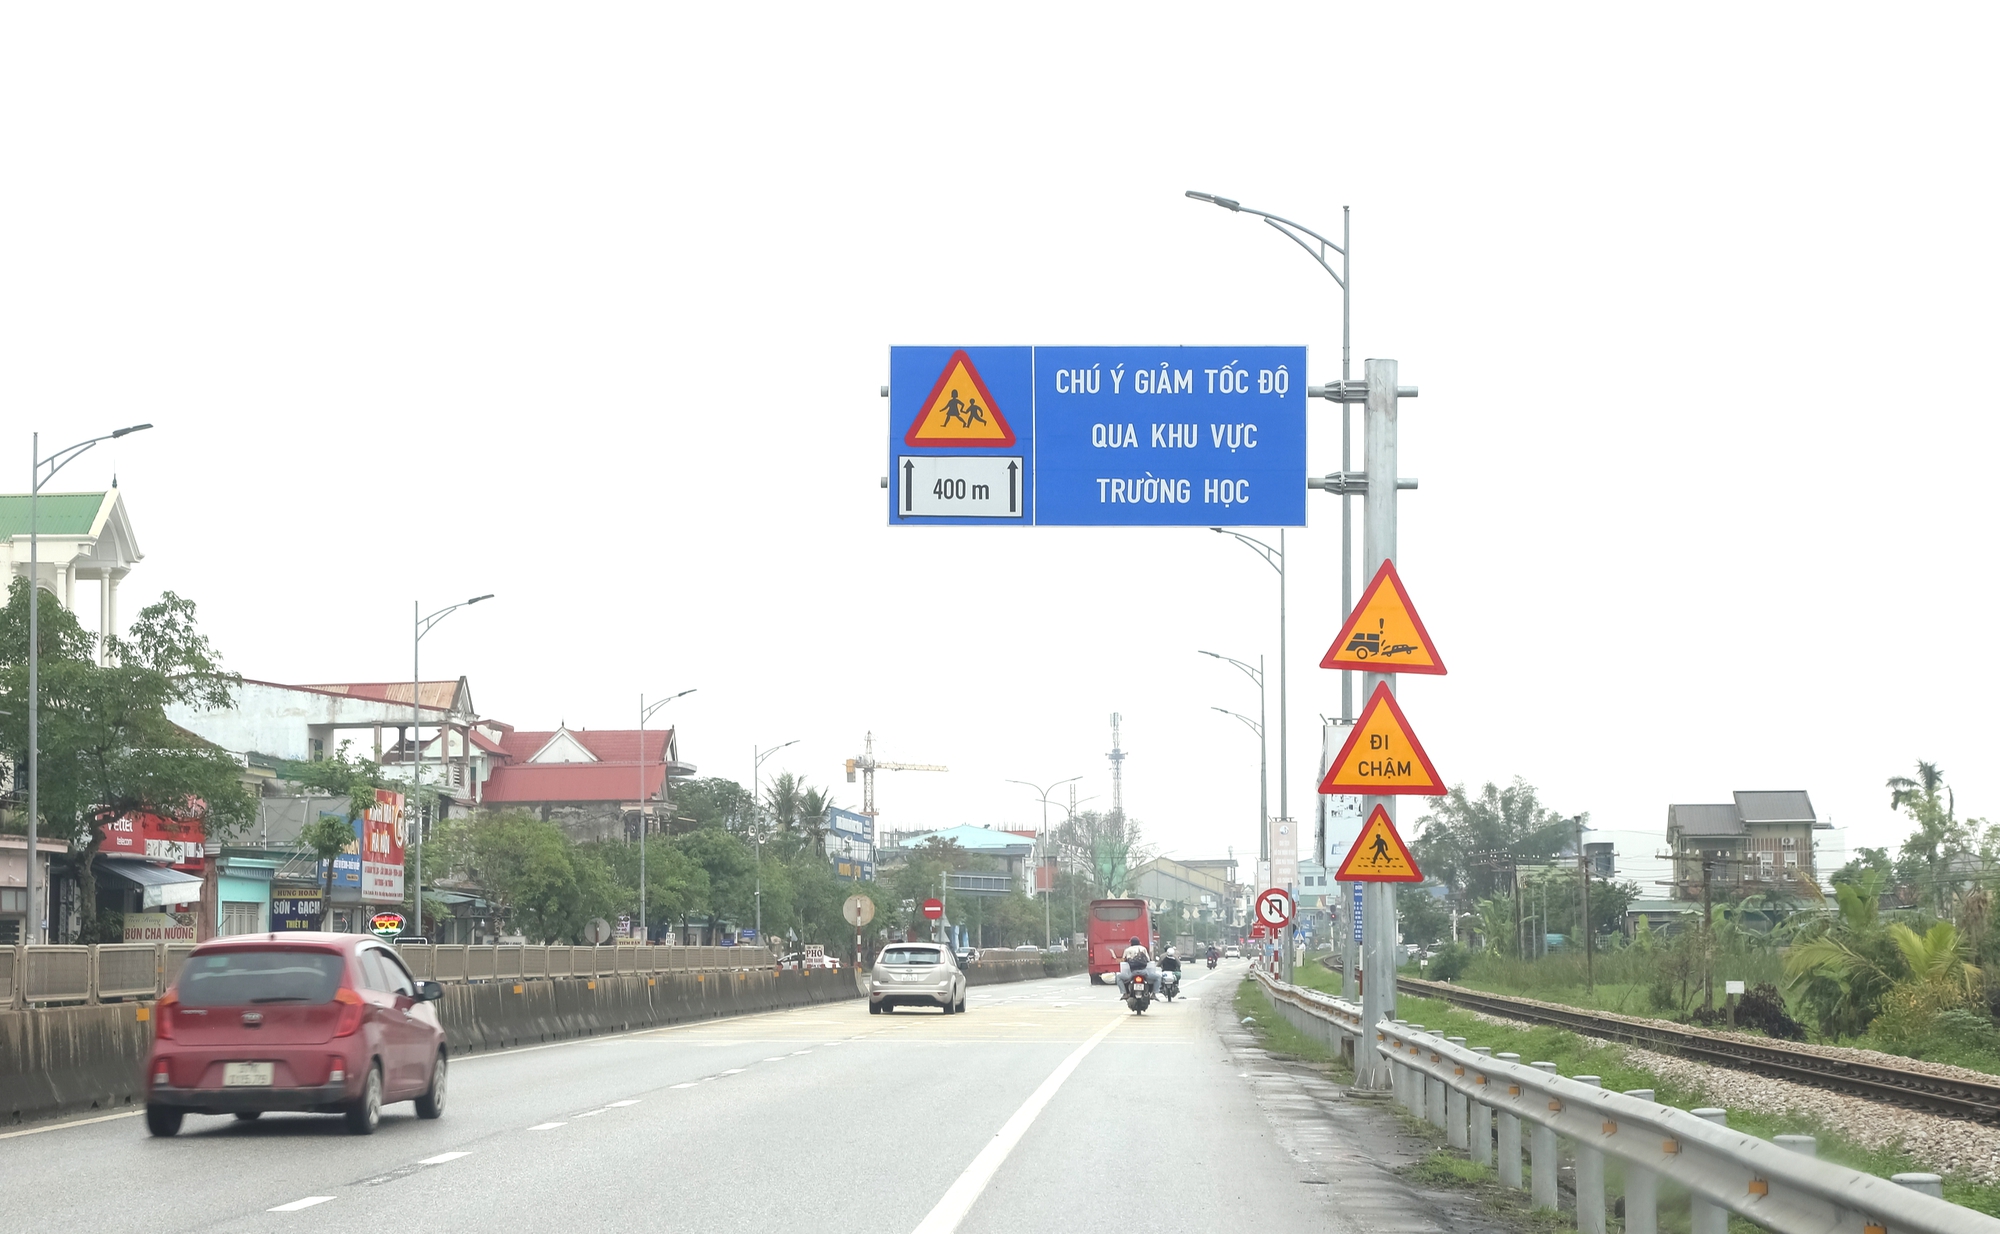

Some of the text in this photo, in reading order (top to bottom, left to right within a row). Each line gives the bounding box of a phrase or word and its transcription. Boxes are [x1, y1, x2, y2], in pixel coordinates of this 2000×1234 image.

[1055, 359, 1289, 398] CHÚ Ý GIẢM TỐC ĐỘ
[1091, 422, 1258, 453] QUA KHU VỰC
[932, 478, 990, 500] 400 m
[1096, 471, 1250, 508] TRƯỜNG HỌC
[1369, 734, 1389, 750] ĐI
[1358, 756, 1411, 779] CHẬM
[273, 899, 291, 915] SƠN
[297, 900, 320, 917] GẠCH
[124, 923, 194, 940] BÚN CHẢ NƯỚNG
